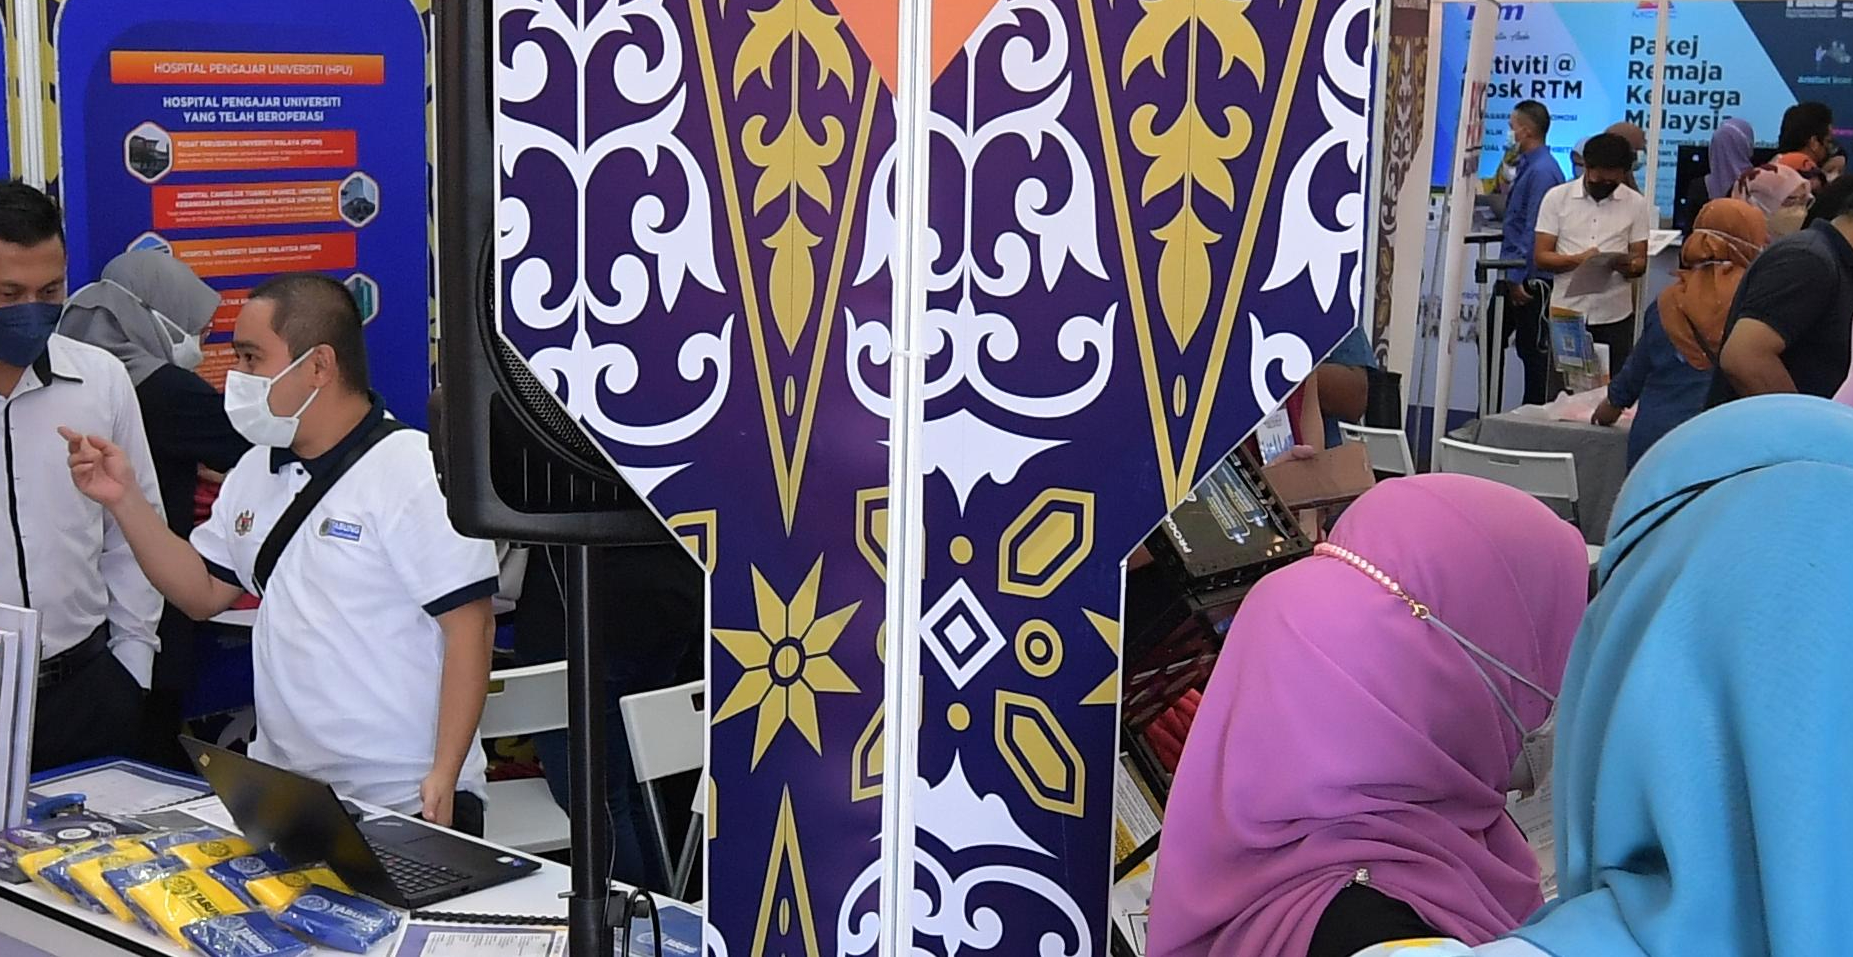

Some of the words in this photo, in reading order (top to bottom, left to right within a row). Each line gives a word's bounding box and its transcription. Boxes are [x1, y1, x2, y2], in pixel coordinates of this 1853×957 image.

[1630, 35, 1699, 59] Pakej
[154, 62, 206, 74] HOSPITAL
[209, 63, 266, 75] PENGAJAR
[268, 63, 323, 75] UNIVERSITI
[1463, 55, 1549, 75] tiviti
[1628, 60, 1723, 85] Remaja
[1531, 80, 1583, 100] RTM
[1626, 85, 1741, 111] Keluarga
[163, 96, 219, 108] HOSPITAL
[221, 96, 280, 108] PENGAJAR
[283, 96, 341, 107] UNIVERSITI
[183, 111, 216, 123] YANG
[218, 111, 255, 122] TELAH
[257, 110, 324, 122] BEROPERASI
